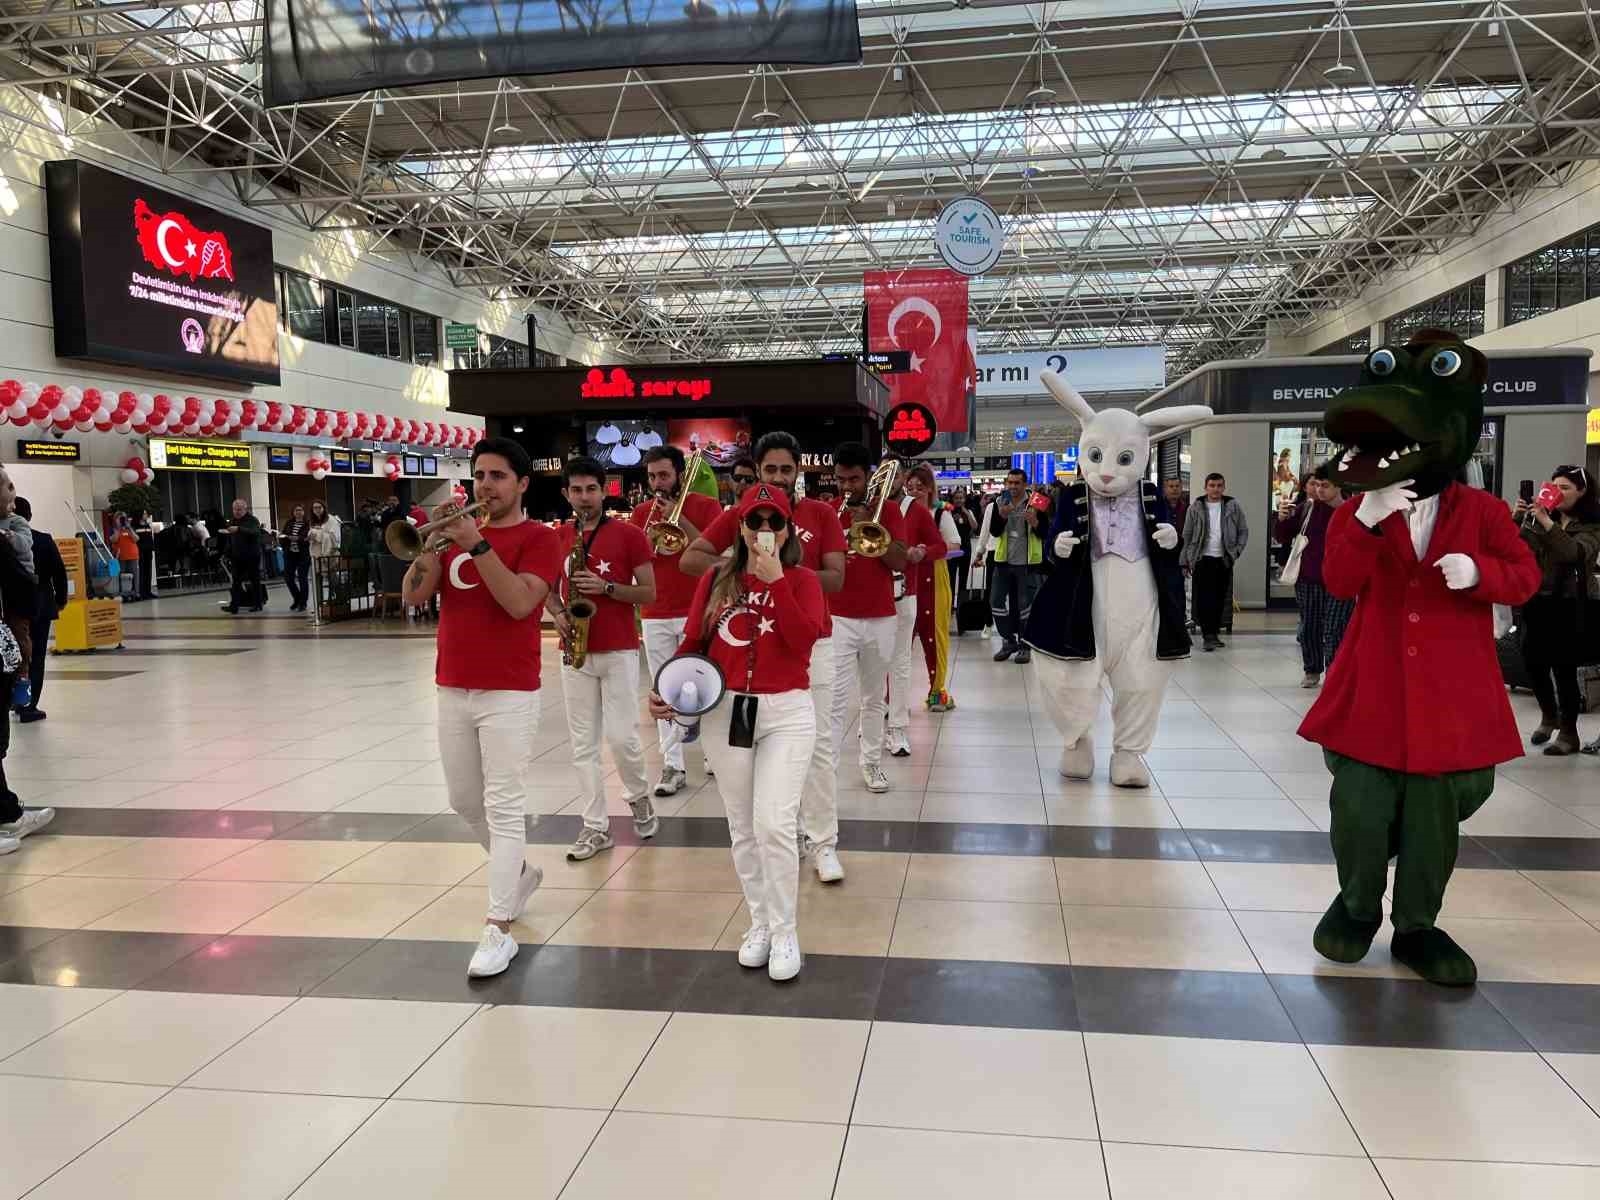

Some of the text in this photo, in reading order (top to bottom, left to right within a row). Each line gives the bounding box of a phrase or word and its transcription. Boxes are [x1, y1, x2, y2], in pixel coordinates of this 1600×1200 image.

[960, 226, 980, 235] SAFE
[951, 233, 990, 245] TOURISM
[1492, 381, 1537, 393] CLUB
[1272, 387, 1344, 400] BEVERLY
[207, 447, 234, 458] Charging
[234, 448, 249, 457] Point
[532, 458, 549, 471] COFFEE
